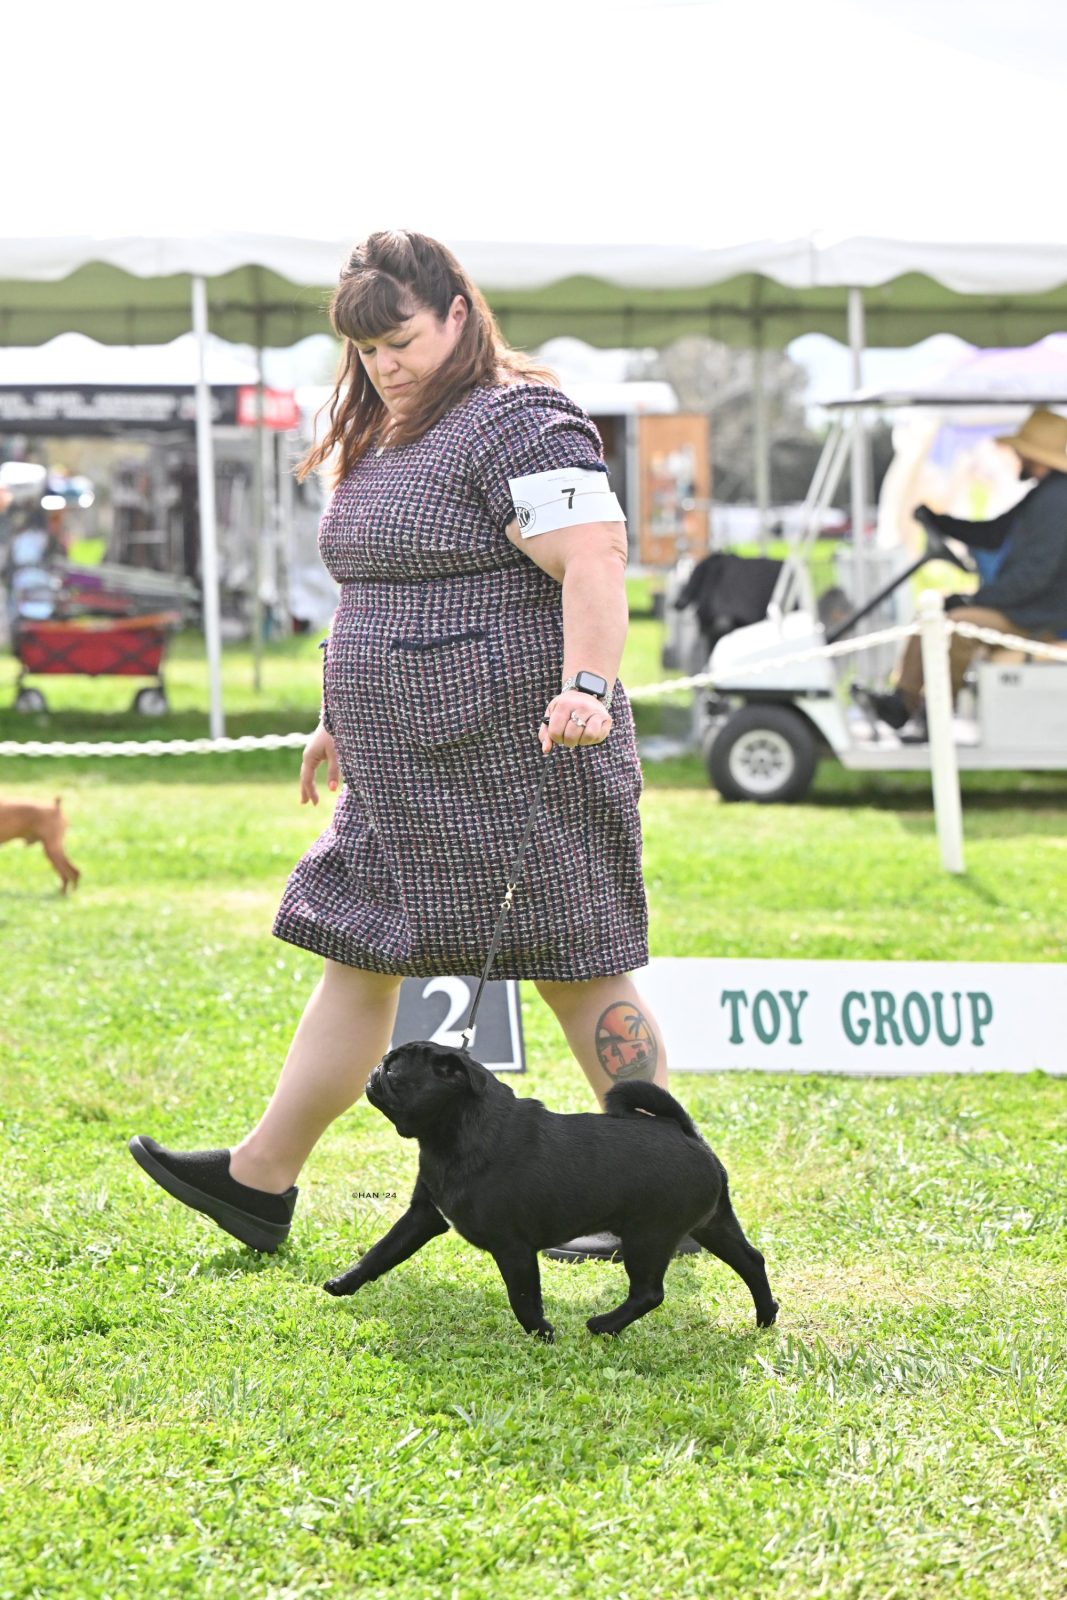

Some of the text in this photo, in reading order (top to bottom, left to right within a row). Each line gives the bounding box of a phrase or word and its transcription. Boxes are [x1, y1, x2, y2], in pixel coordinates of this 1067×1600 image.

[561, 488, 575, 509] 7
[422, 976, 477, 1048] 2
[721, 990, 993, 1047] TOY GROUP
